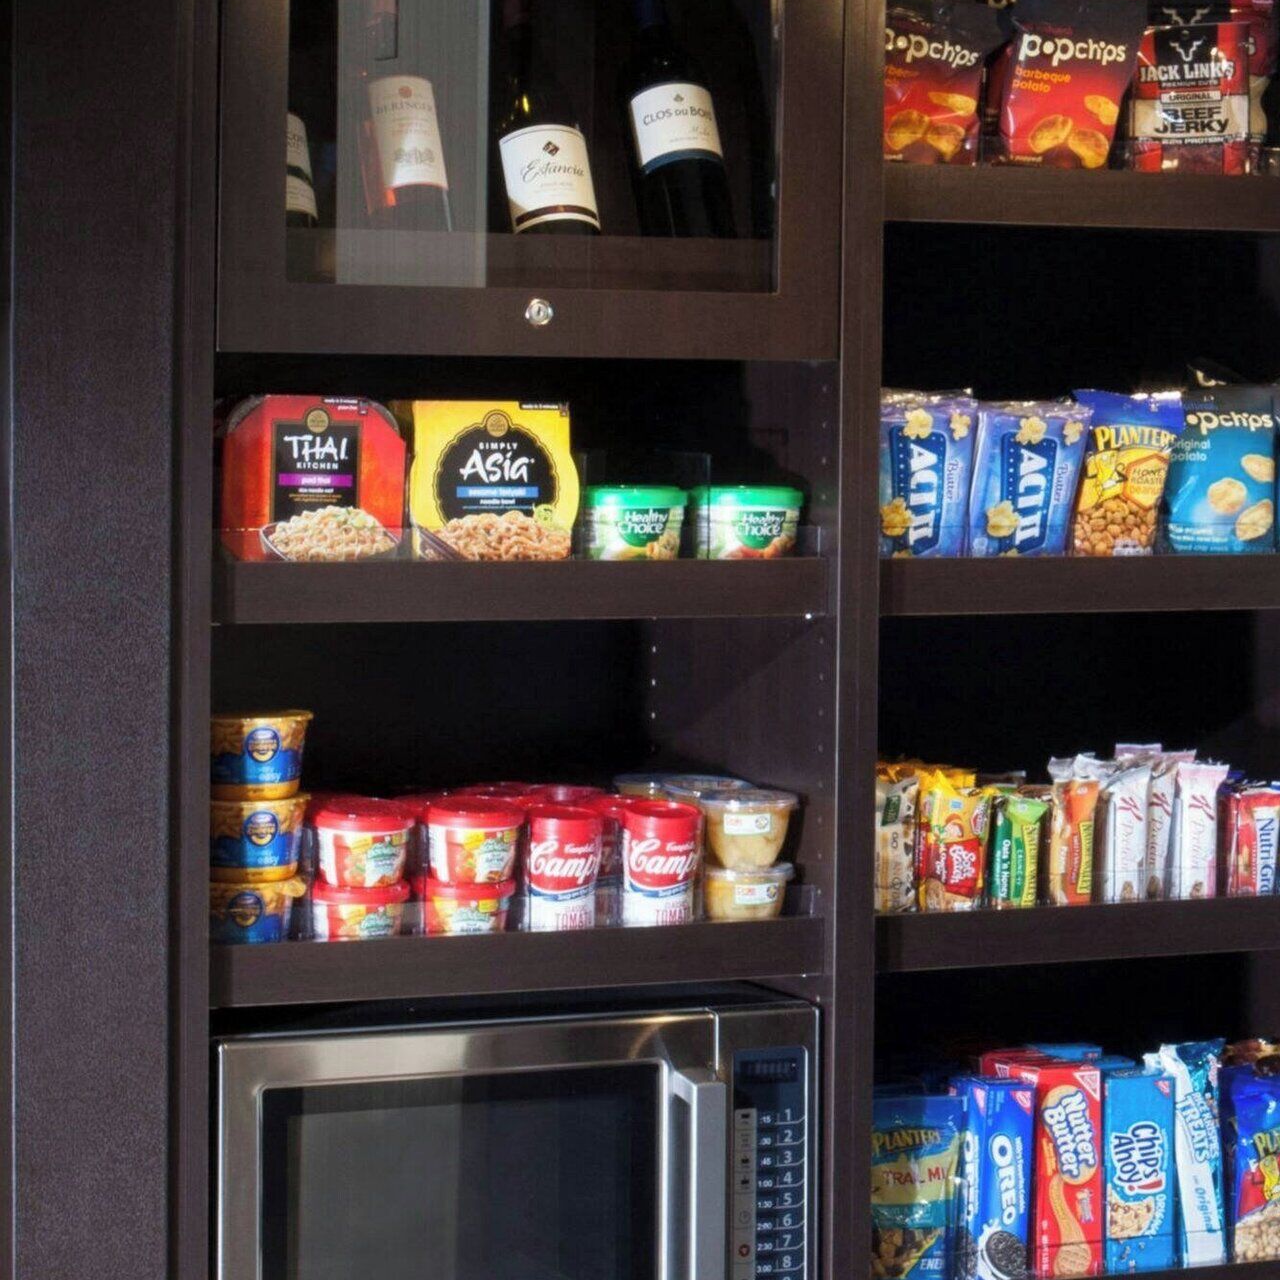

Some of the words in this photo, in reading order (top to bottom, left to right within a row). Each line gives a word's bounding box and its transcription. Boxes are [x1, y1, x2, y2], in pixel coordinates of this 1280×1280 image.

[1019, 33, 1126, 67] popchips
[1140, 65, 1181, 82] JACK
[643, 108, 674, 126] CLOS
[1155, 119, 1229, 134] JERKY
[1186, 411, 1274, 435] opchips
[283, 434, 348, 462] THAI
[479, 442, 518, 450] SIMPLY
[296, 462, 339, 470] KITCHEN
[909, 443, 939, 506] ACT
[946, 458, 960, 501] Butter
[1017, 448, 1048, 509] ACT
[1053, 463, 1069, 503] Butter
[624, 510, 668, 524] Healthy
[742, 511, 786, 525] Healthy
[617, 521, 665, 535] Choice
[736, 523, 781, 536] Choice
[530, 840, 598, 884] Camp
[630, 838, 698, 881] Camp
[1000, 871, 1010, 898] Honey
[785, 1109, 791, 1121] 1
[784, 1129, 793, 1142] 2
[1059, 1090, 1096, 1168] Nutter
[1176, 1096, 1209, 1164] TREATS
[1043, 1104, 1081, 1180] Butter
[784, 1150, 792, 1164] 3
[1129, 1122, 1160, 1180] Chips
[783, 1171, 793, 1184] 4
[990, 1134, 1017, 1226] OREO
[783, 1192, 792, 1205] 5
[783, 1213, 792, 1227] 6
[783, 1234, 792, 1247] 7
[782, 1255, 792, 1268] 8
